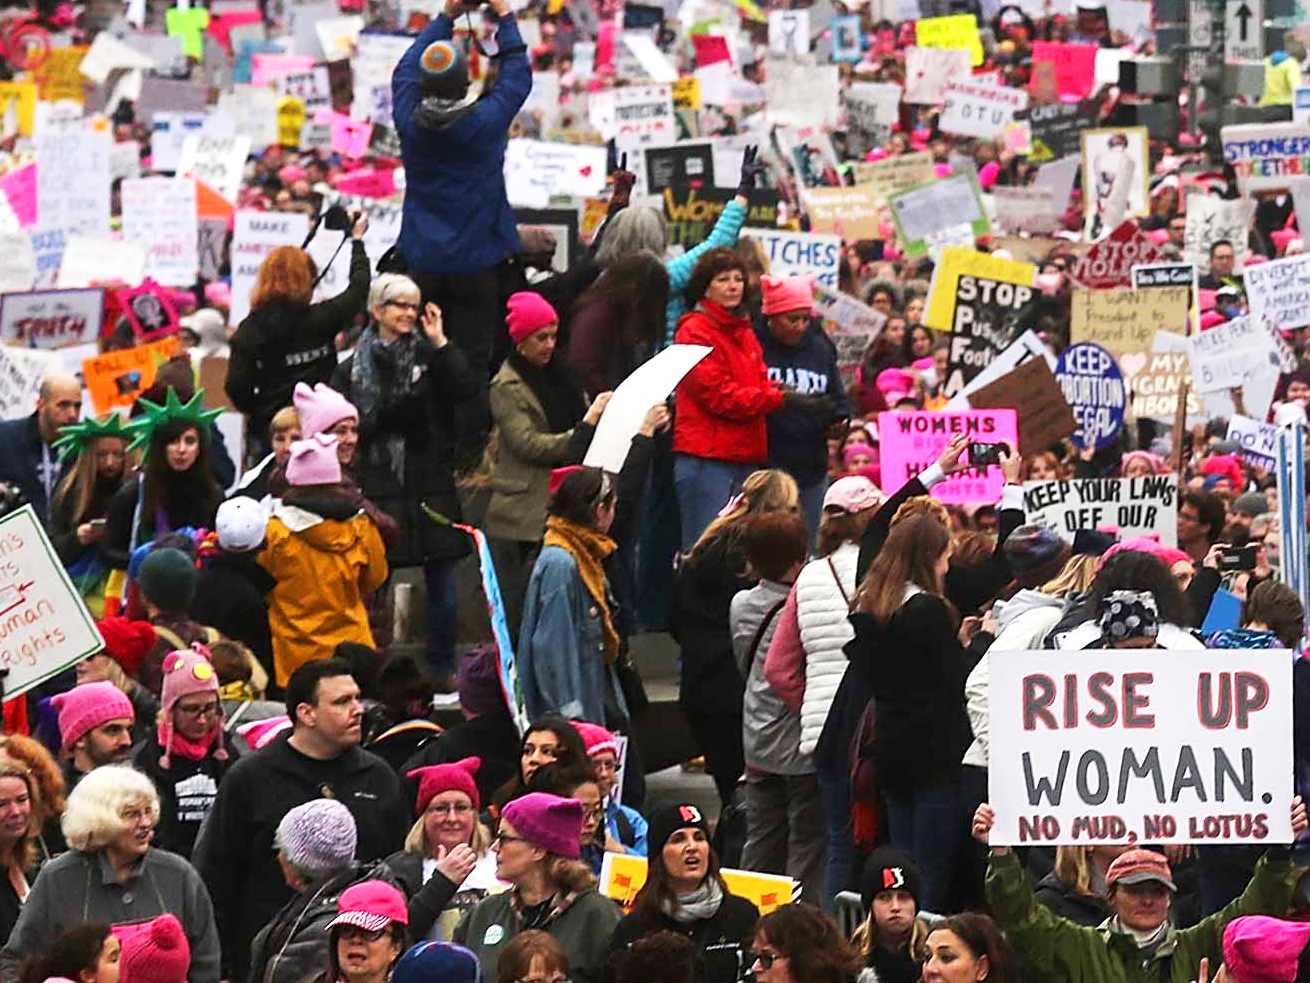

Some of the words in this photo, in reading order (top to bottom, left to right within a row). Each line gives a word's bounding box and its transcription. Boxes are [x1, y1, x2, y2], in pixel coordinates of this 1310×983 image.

[766, 238, 838, 269] TCHES
[957, 275, 1034, 309] STOP
[1064, 345, 1114, 377] KEEP
[1150, 353, 1187, 375] MY
[1060, 373, 1124, 409] BORTION
[896, 416, 998, 435] WOMENS
[1072, 405, 1118, 449] EGAL
[1023, 480, 1072, 514] KEEP
[1074, 479, 1122, 505] YOUR
[1130, 476, 1177, 508] LAWS
[1063, 507, 1105, 533] OFF
[1117, 505, 1159, 530] OUR
[0, 599, 56, 640] uman
[1021, 671, 1156, 731] RISE
[1197, 671, 1271, 731] UP
[1021, 745, 1274, 808] WOMAN.
[1018, 813, 1062, 842] NO
[1070, 814, 1139, 845] MUD,
[1143, 812, 1179, 840] NO
[1187, 812, 1270, 840] LOTUS
